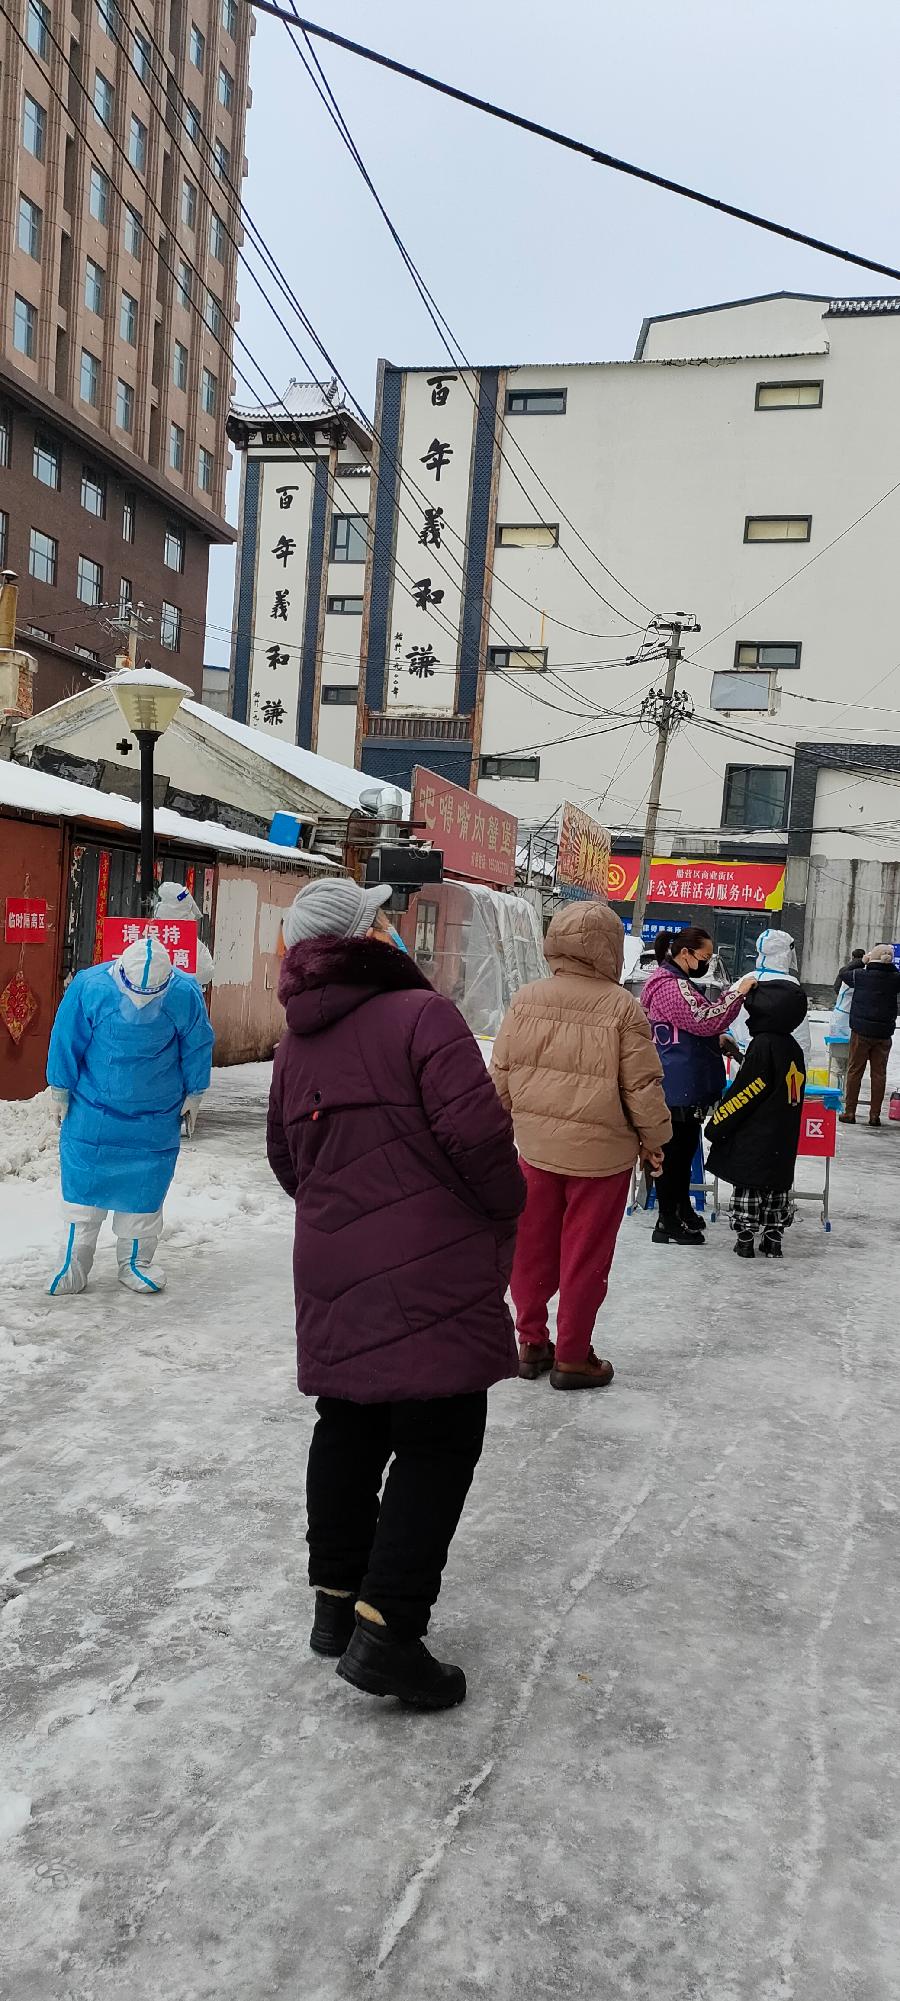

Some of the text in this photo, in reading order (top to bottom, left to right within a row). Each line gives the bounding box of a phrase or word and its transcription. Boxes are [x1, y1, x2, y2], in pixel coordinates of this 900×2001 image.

[675, 868, 735, 881] 船营区商业街区
[8, 911, 45, 930] 临时隔离区
[121, 923, 181, 945] 请保持
